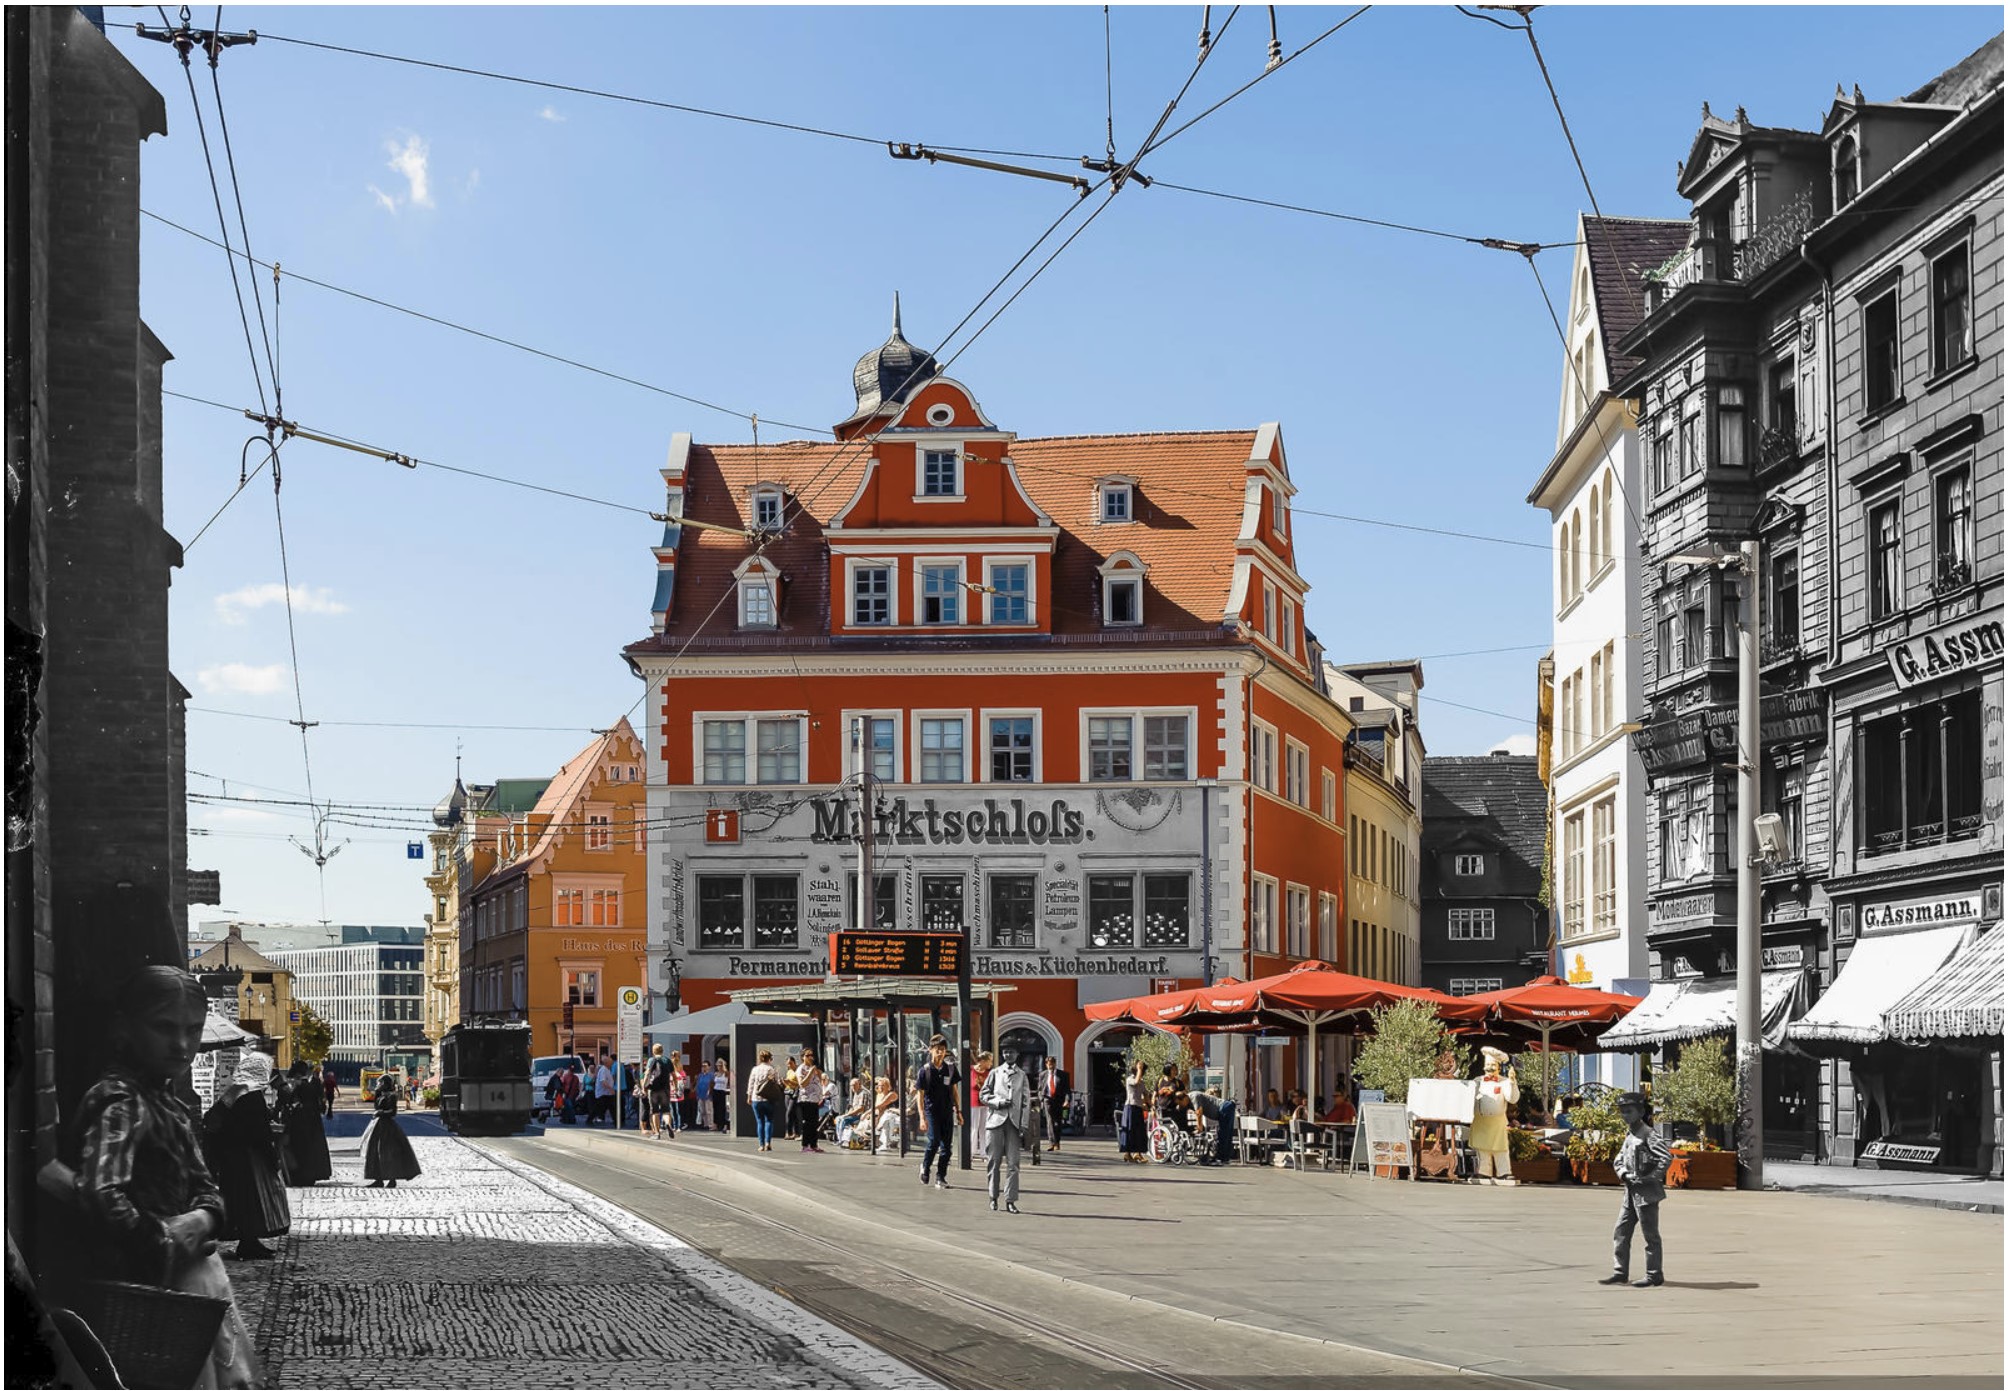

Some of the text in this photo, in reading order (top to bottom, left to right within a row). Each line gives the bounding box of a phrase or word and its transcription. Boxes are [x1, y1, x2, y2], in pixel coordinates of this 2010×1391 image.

[808, 894, 841, 902] waaren
[1045, 905, 1079, 917] Lampen
[562, 939, 600, 951] Haus
[604, 939, 626, 951] des
[729, 956, 829, 975] Permanent
[976, 956, 1022, 975] Haus
[1025, 962, 1037, 974] &
[1039, 956, 1169, 975] Küchenbedarf.
[490, 1091, 505, 1102] 14
